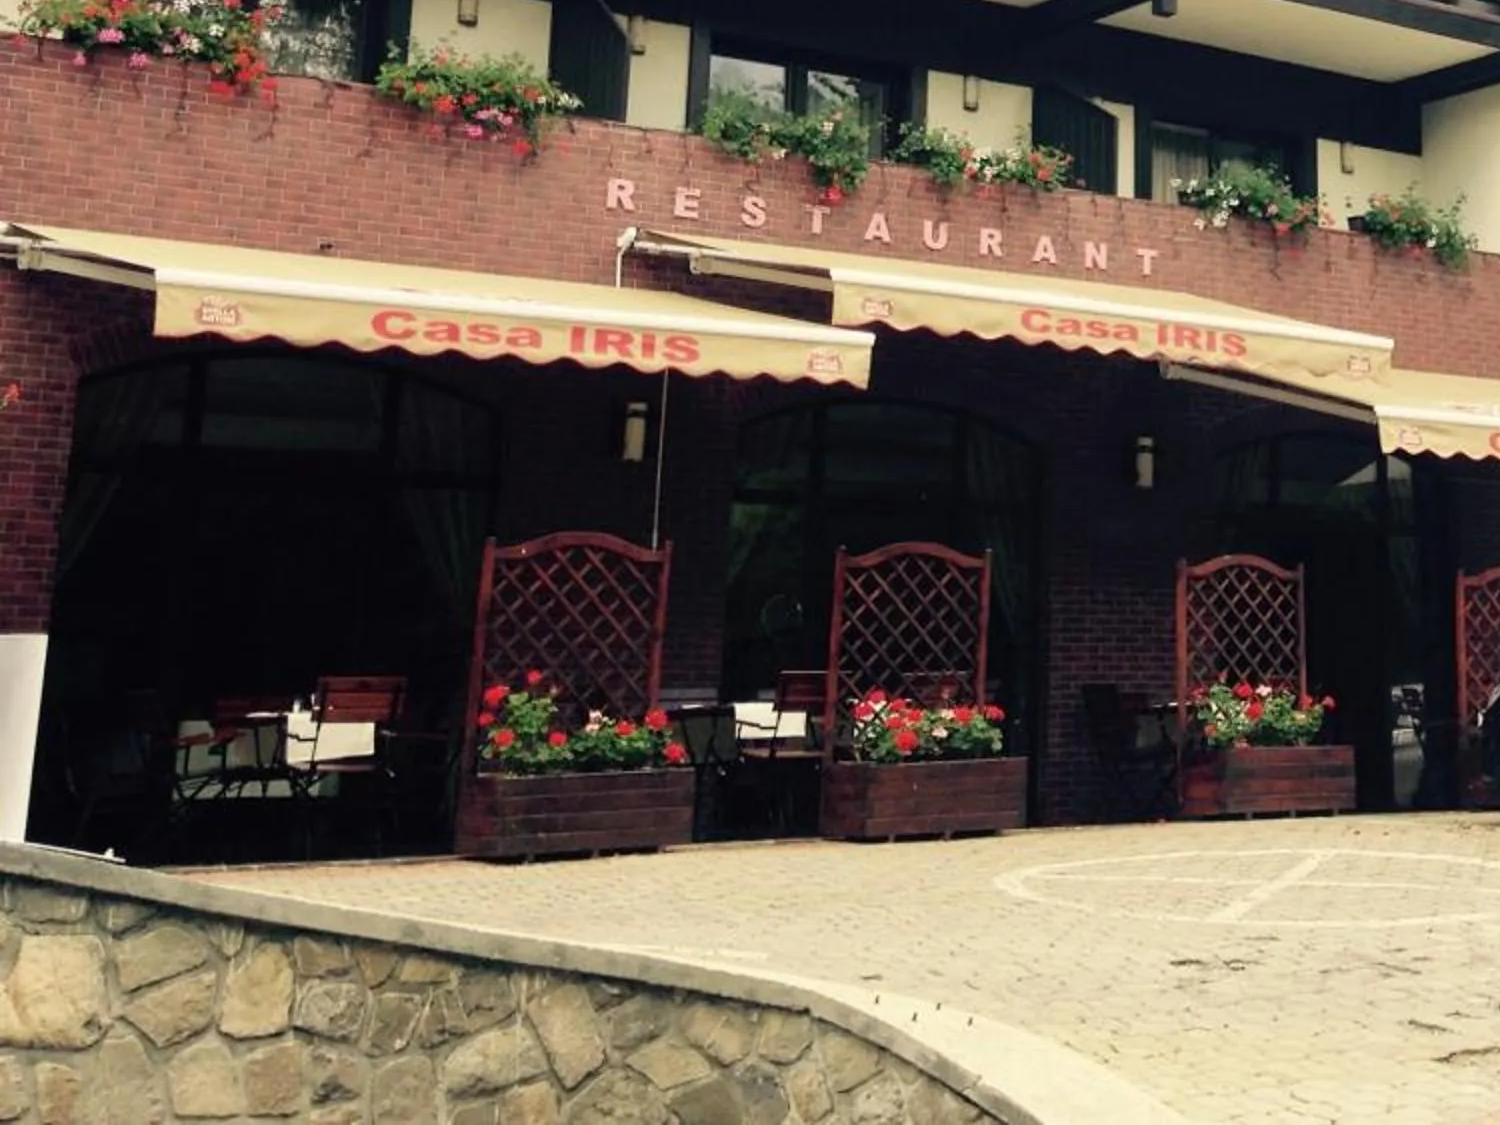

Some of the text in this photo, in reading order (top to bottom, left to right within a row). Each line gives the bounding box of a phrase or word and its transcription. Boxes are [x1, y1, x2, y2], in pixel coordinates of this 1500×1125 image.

[605, 177, 1162, 276] RESTAURANT
[370, 309, 701, 365] Casa IRIS
[1020, 308, 1248, 358] Casa IRIS
